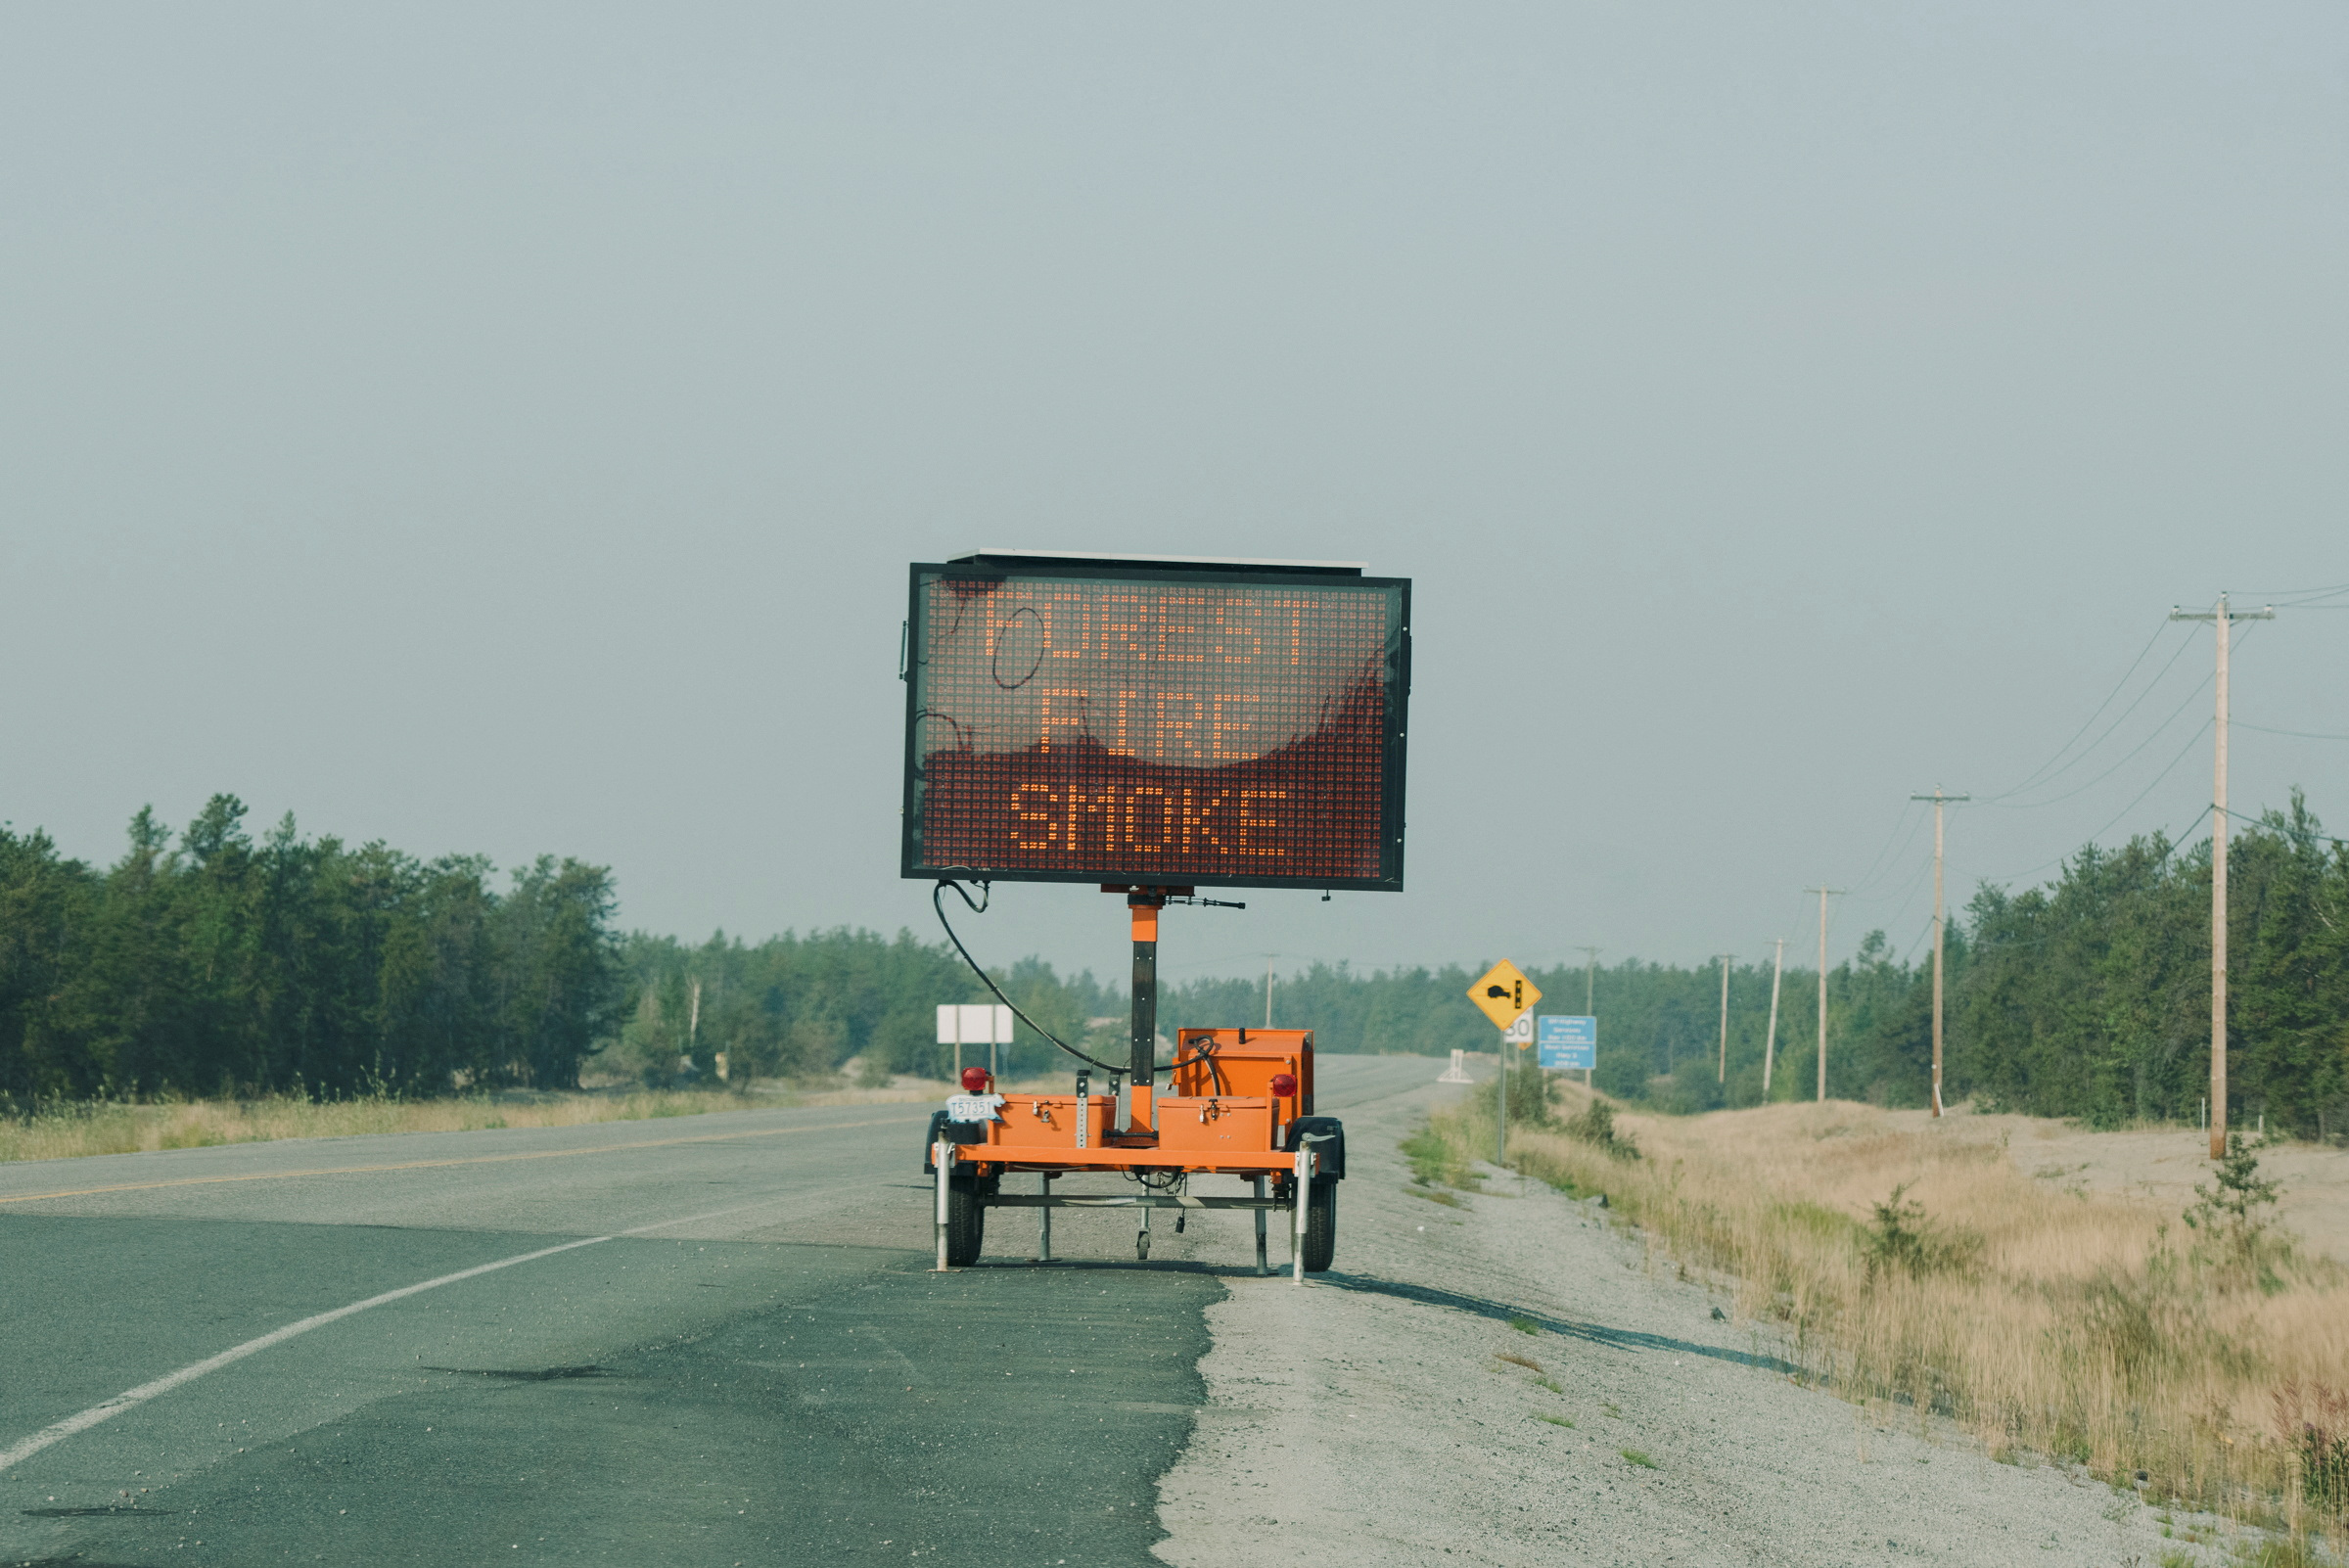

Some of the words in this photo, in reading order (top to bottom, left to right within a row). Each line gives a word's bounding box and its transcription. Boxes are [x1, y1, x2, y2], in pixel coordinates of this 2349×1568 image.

[985, 589, 1319, 667] FOREST
[1039, 687, 1261, 761] FIRE
[1009, 783, 1287, 857] SMOKE
[951, 1101, 991, 1114] T57351
